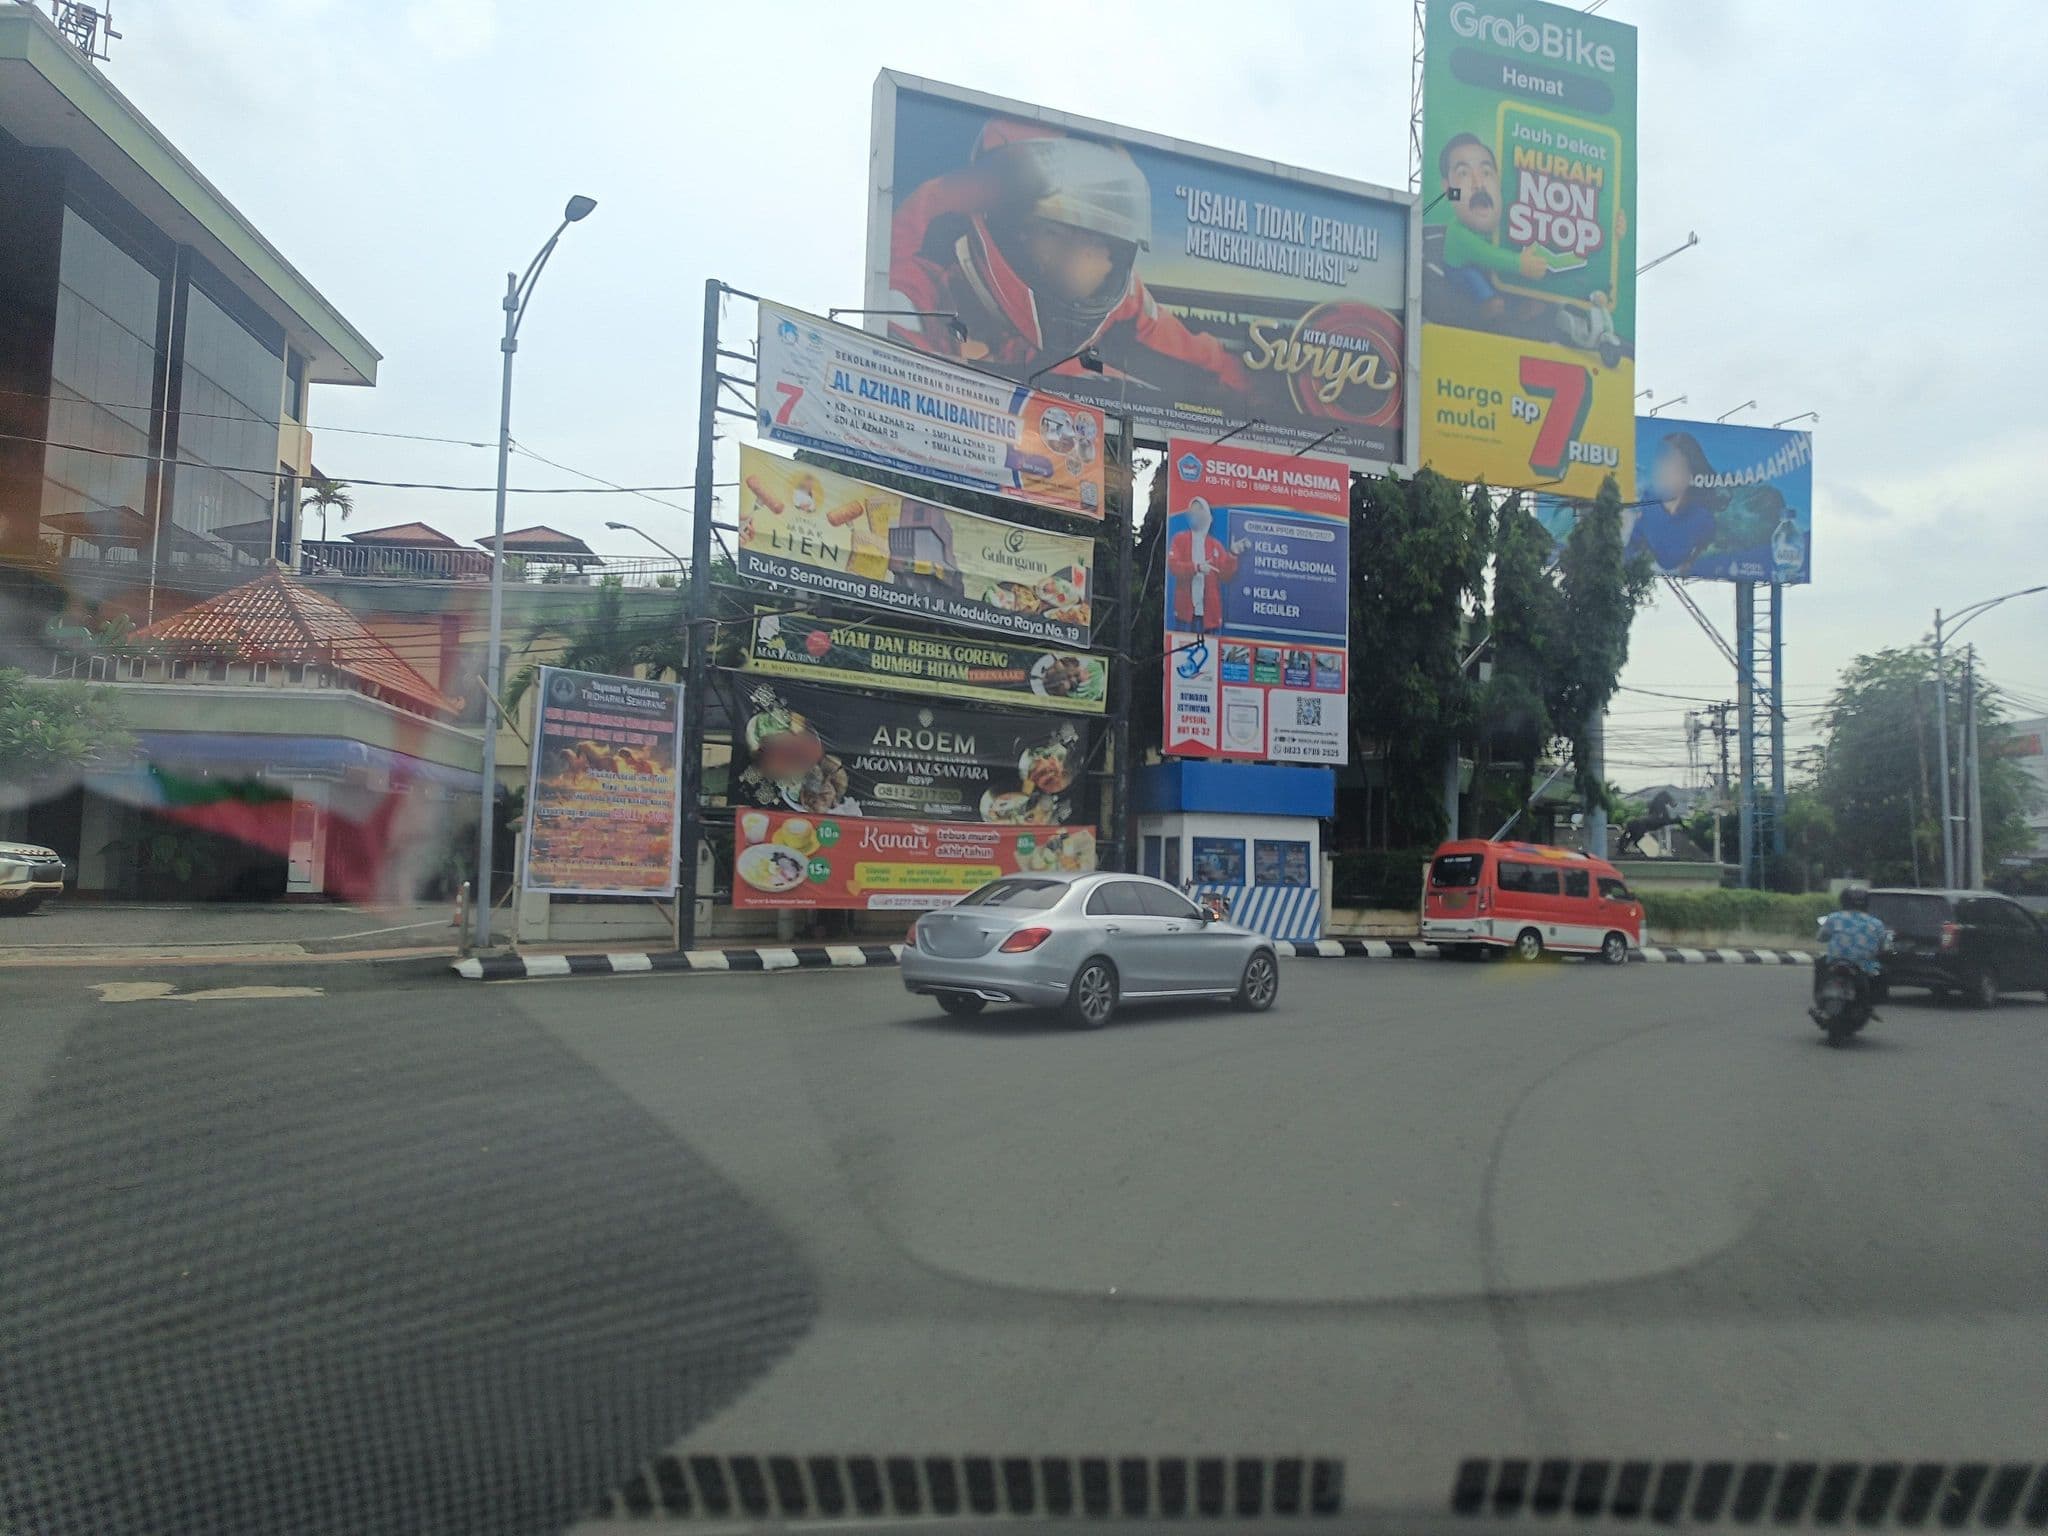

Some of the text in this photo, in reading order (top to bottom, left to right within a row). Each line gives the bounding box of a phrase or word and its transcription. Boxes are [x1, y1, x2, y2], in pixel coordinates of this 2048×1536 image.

[1450, 1, 1616, 72] GrabBike
[1502, 66, 1563, 97] Hemat
[1512, 122, 1606, 160] Jauh Dekat
[1514, 145, 1604, 187] MURAH
[1518, 171, 1597, 221] NON
[1254, 202, 1306, 247] TIDAK
[1310, 215, 1379, 261] PERNAH
[1508, 204, 1603, 256] STOP
[1185, 225, 1301, 282] MENGKHIANATI
[1303, 329, 1370, 354] KITA ADALAH
[1243, 319, 1399, 403] Surya
[835, 350, 877, 370] SEKOLAH
[878, 362, 905, 379] ISLAM
[907, 370, 943, 391] TERBAIK
[944, 381, 956, 393] DI
[956, 385, 1001, 406] SEMARANG
[1436, 377, 1503, 408] Harga
[775, 381, 805, 425] 7
[833, 368, 854, 395] AL
[857, 376, 912, 411] AZHAR
[915, 393, 1017, 441] KALIBANTENG
[1436, 407, 1496, 431] mulai
[1511, 395, 1541, 424] Rp
[1519, 355, 1593, 480] 7
[1568, 440, 1619, 468] RIBU
[1205, 459, 1342, 492] SEKOLAH NASIMA
[771, 529, 839, 562] LIEN
[1254, 540, 1289, 557] KELAS
[1253, 556, 1337, 576] INTERNASIONAL
[749, 556, 788, 578] Ruko
[790, 565, 867, 598] Semarang
[869, 583, 925, 611] Bizpark
[949, 602, 1013, 628] Madukoro
[1014, 613, 1044, 636] Raya
[1067, 626, 1080, 641] 19
[1253, 586, 1288, 602] KELAS
[1253, 601, 1301, 619] REGULER
[830, 627, 1009, 668] AYAM DAN BEBEK GORENG
[871, 652, 924, 676] BUMBU
[927, 660, 970, 681] HITAM
[581, 688, 625, 704] TRIDHARMA
[625, 693, 667, 711] SEMARANG
[872, 725, 977, 756] AROEM
[914, 762, 990, 781] NUSANTARA
[859, 826, 931, 853] Kanari
